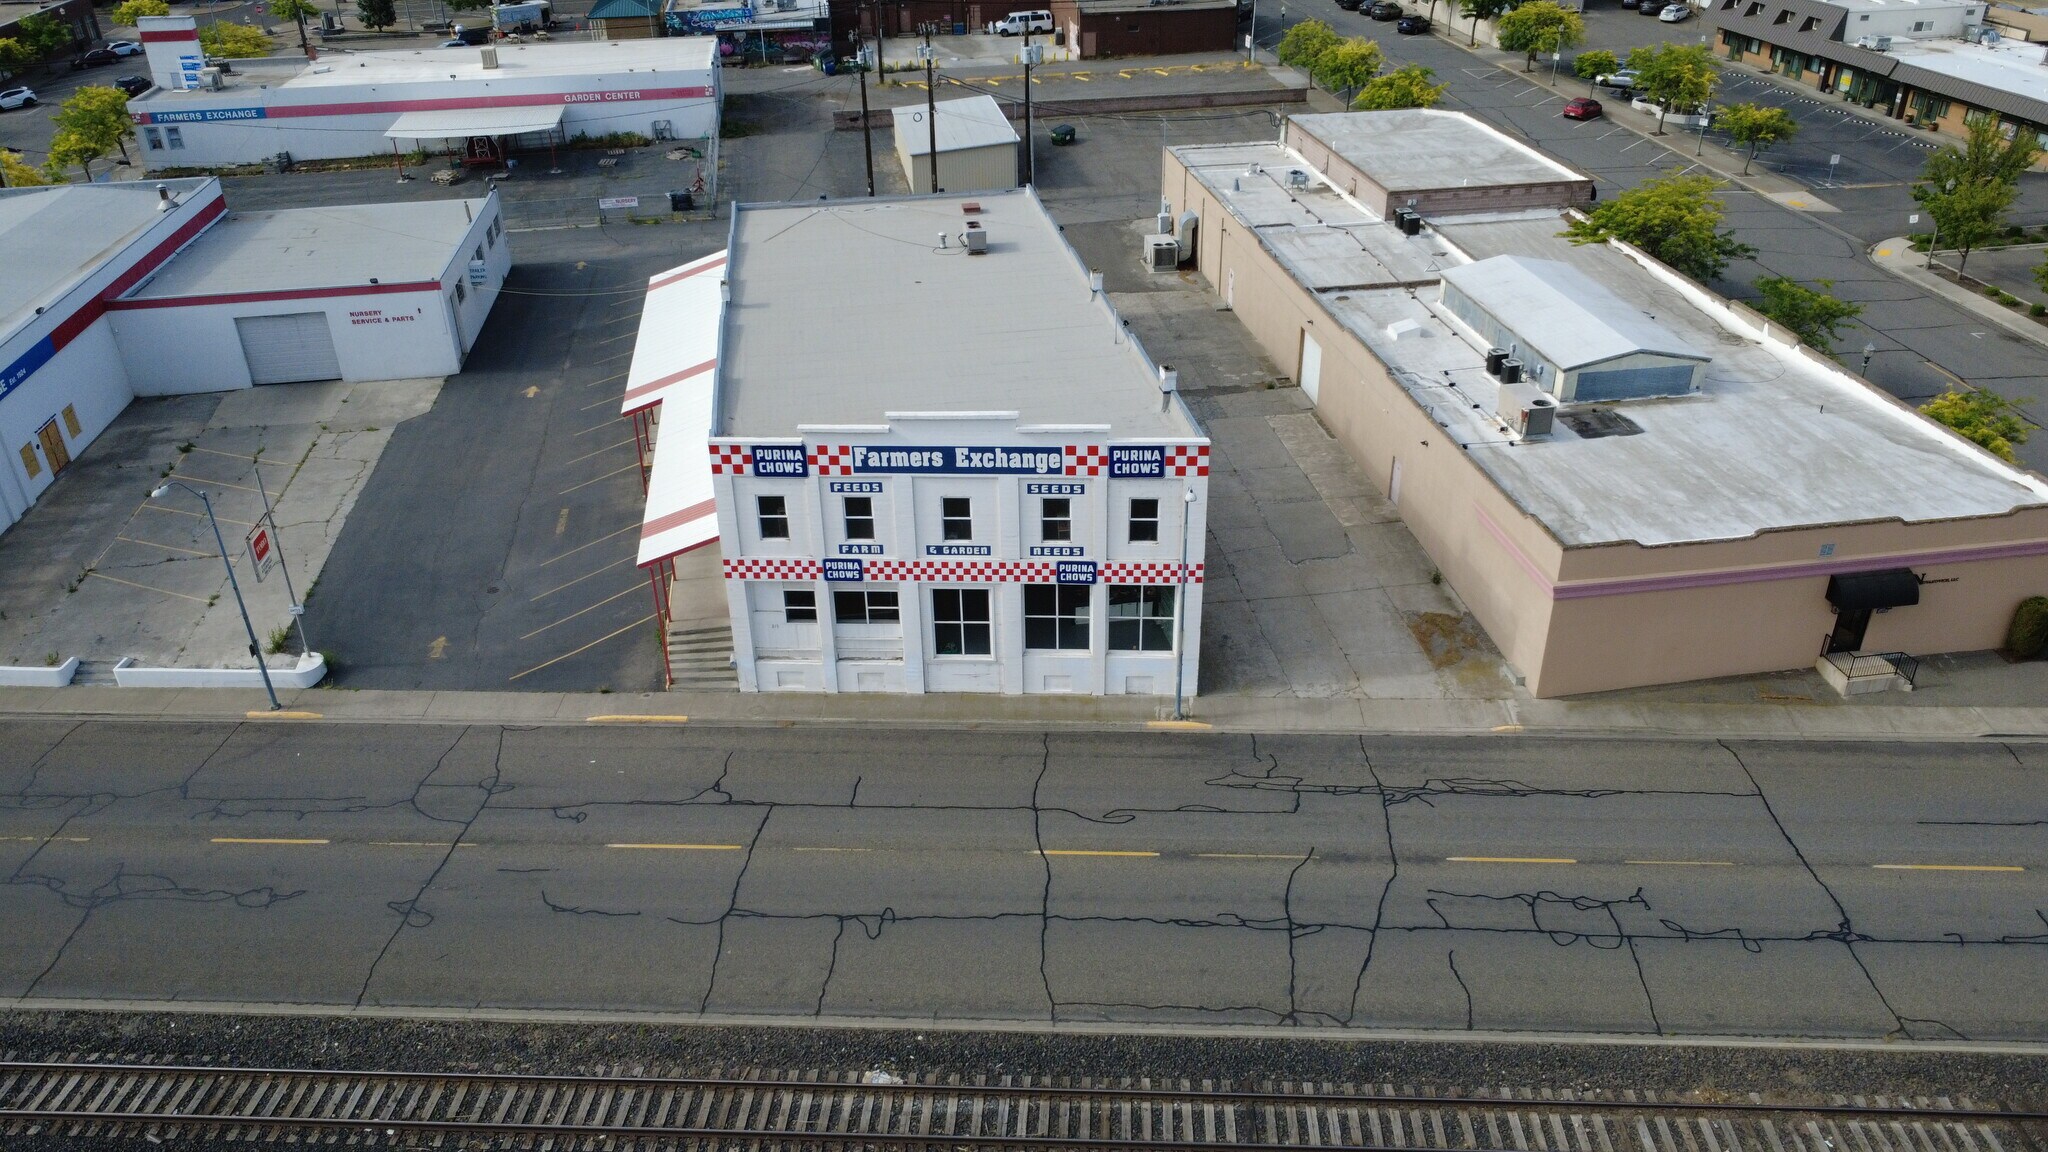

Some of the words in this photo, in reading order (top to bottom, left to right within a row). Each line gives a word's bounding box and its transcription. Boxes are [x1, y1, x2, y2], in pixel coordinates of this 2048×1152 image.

[564, 93, 601, 103] GARDEN
[605, 91, 641, 100] CENTER
[157, 112, 203, 122] FARMERS
[206, 109, 258, 120] EXCHANGE
[351, 317, 383, 325] SERVICE
[392, 315, 415, 323] PARTS
[755, 449, 804, 461] PURINA
[853, 446, 944, 468] Farmers
[955, 447, 1061, 474] Exchange
[1113, 449, 1161, 461] PURINA
[758, 461, 803, 473] CHOWS
[1114, 462, 1160, 474] CHOWS
[833, 483, 880, 492] FEEDS
[1030, 484, 1082, 494] SEEDS
[842, 545, 880, 553] FARM
[929, 546, 937, 554] &
[942, 546, 988, 554] GARDEN
[1033, 547, 1081, 555] NEEDS
[825, 561, 860, 570] PURINA
[1059, 564, 1094, 573] PURINA
[827, 570, 860, 579] CHOWS
[1060, 573, 1093, 581] CHOWS
